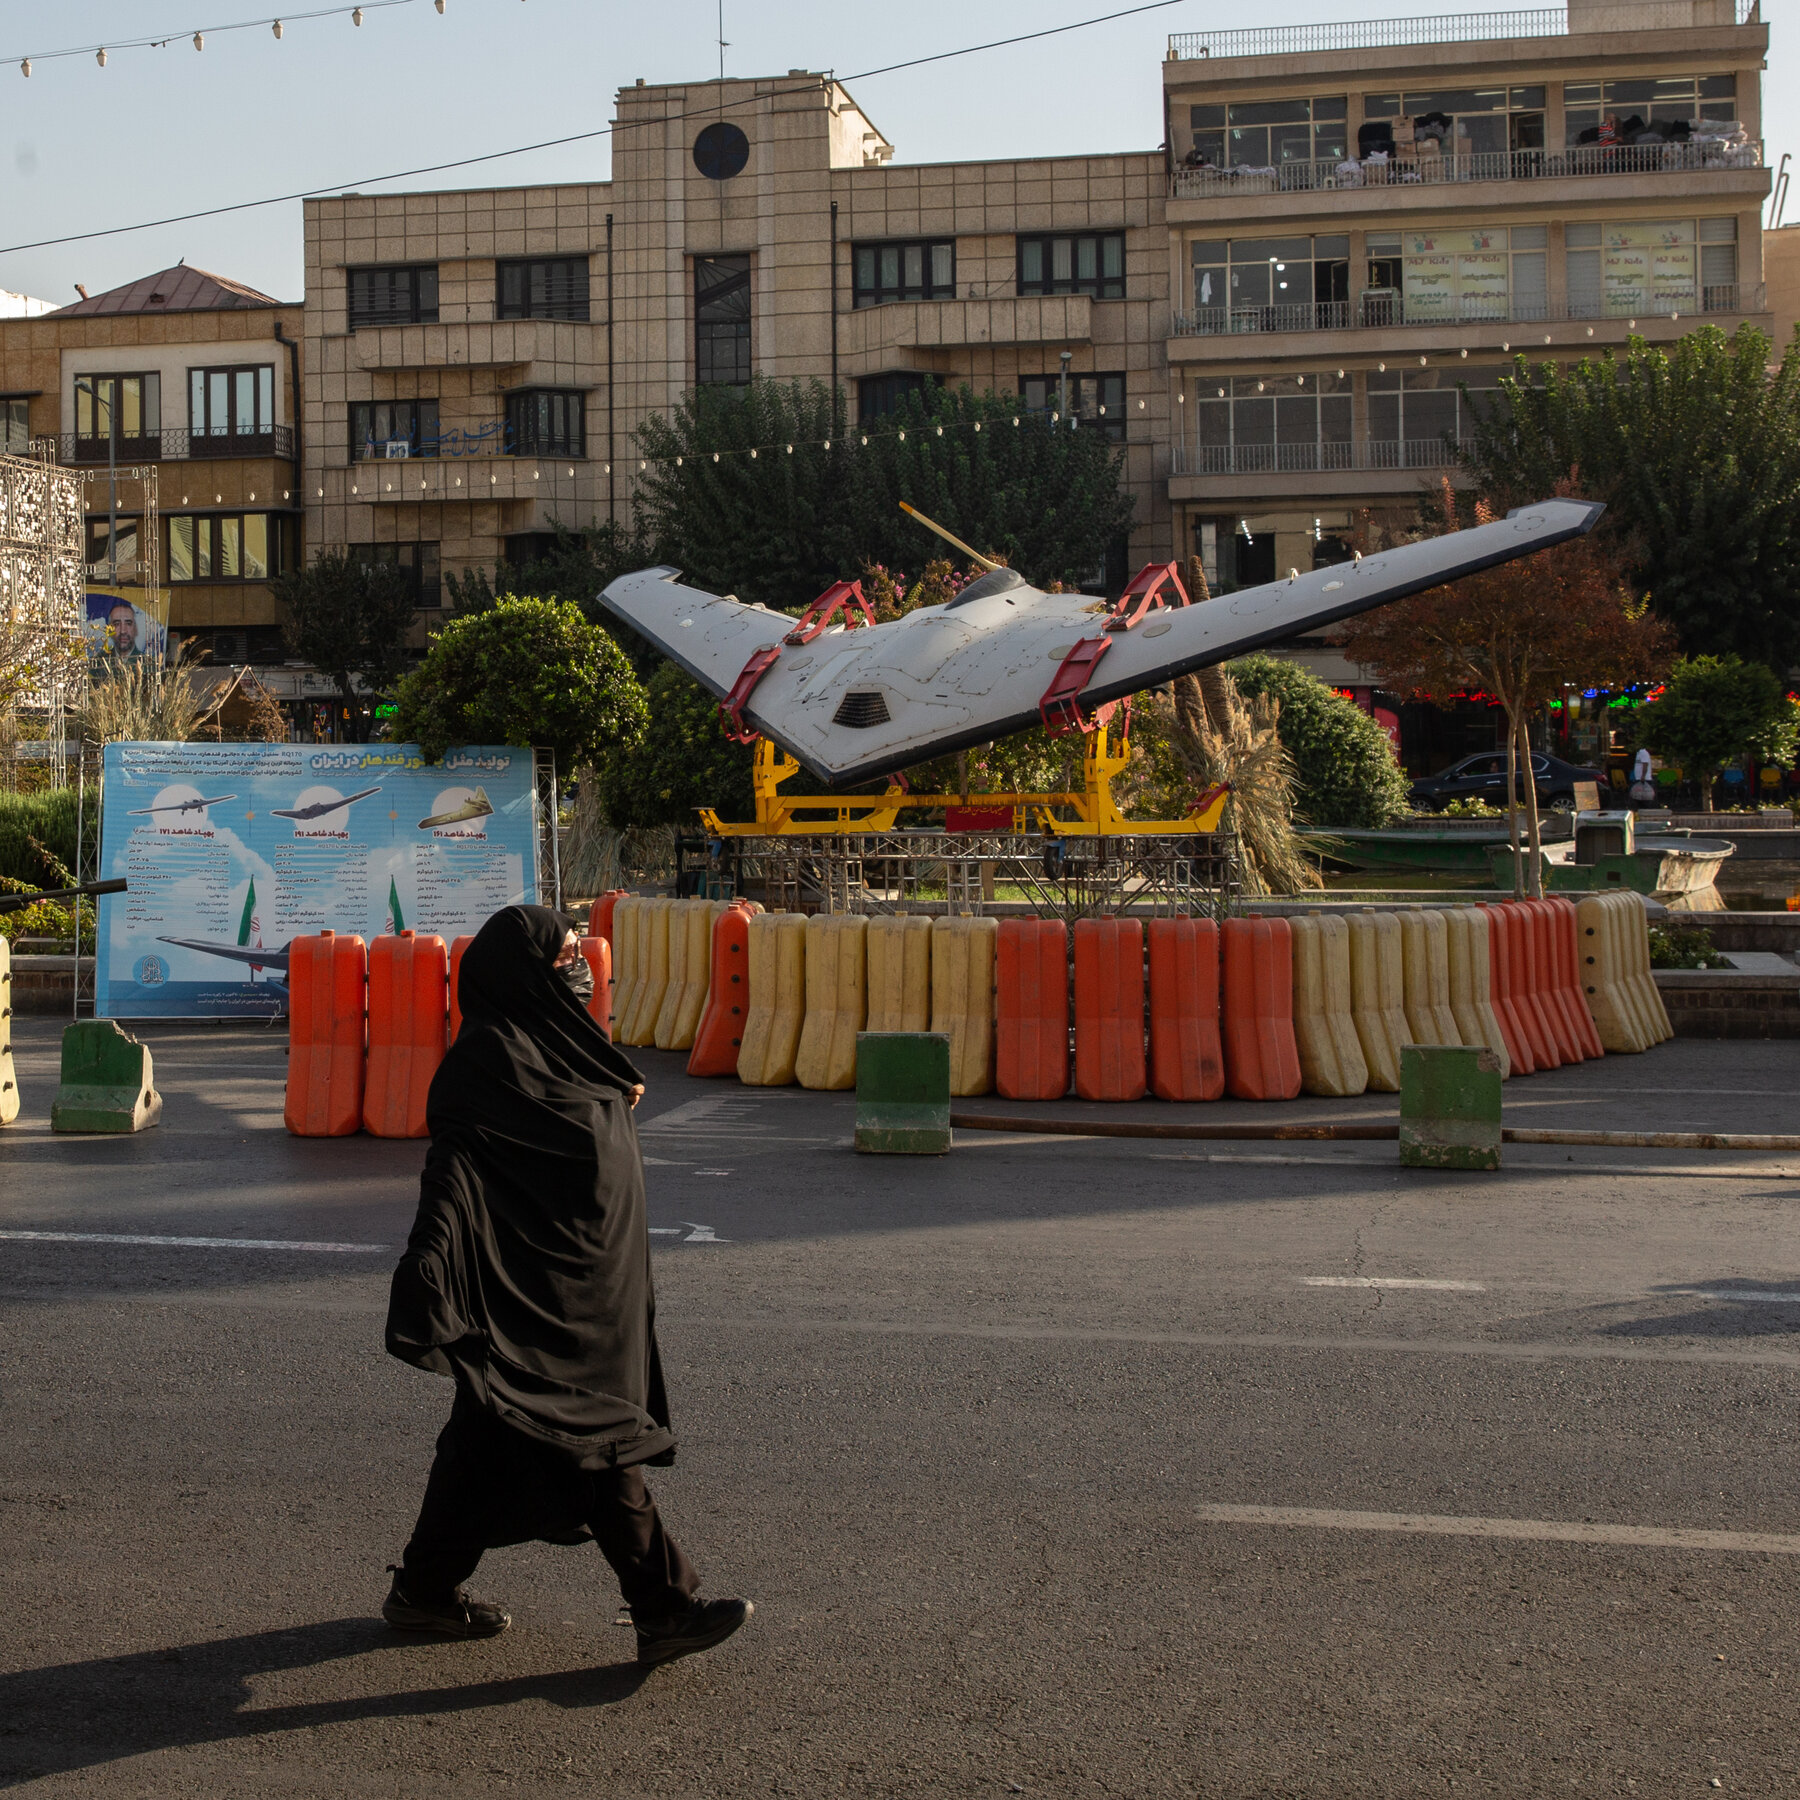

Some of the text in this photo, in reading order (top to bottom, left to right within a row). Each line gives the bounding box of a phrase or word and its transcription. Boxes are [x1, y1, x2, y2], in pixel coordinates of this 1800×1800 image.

[312, 753, 510, 771] تولید مثل جور قندهار در ایران
[194, 828, 215, 838] پهپاد
[328, 830, 349, 839] پهپاد
[466, 830, 486, 840] پهپاد
